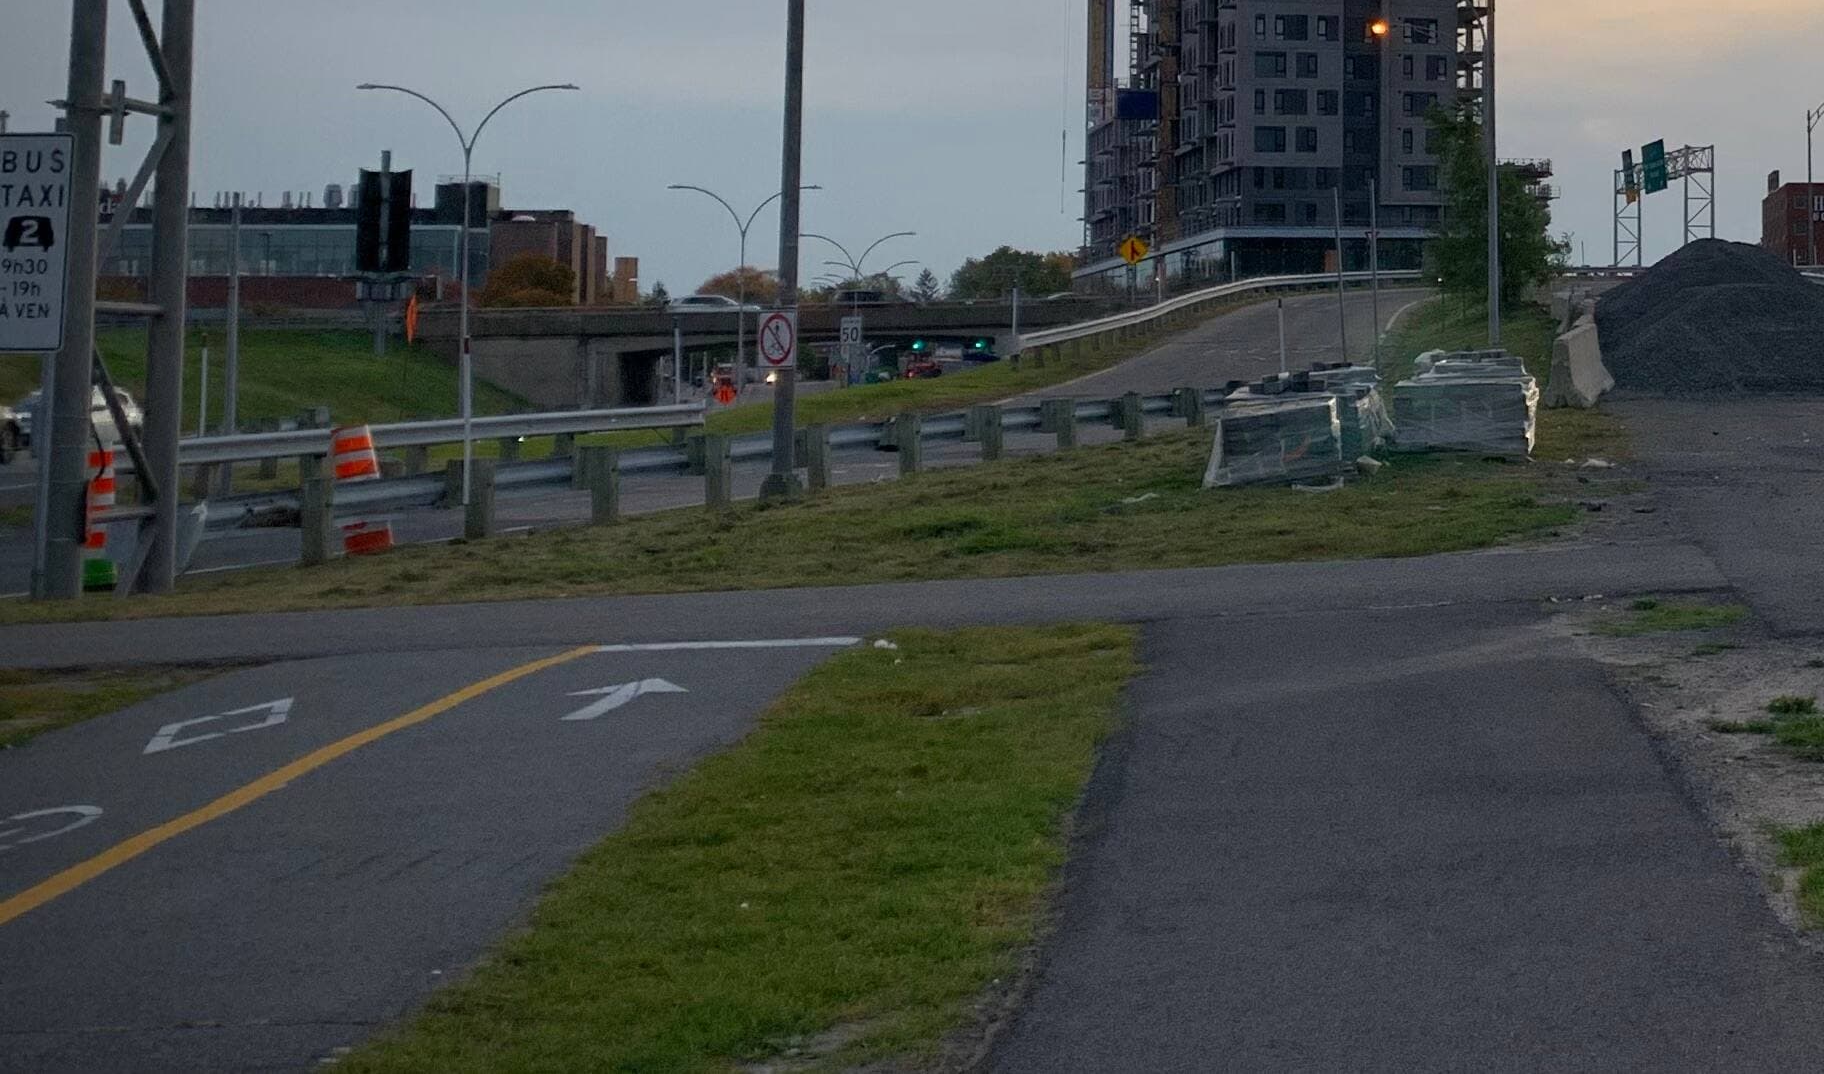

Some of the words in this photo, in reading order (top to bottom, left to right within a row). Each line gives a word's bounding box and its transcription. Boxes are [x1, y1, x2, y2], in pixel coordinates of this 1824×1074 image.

[2, 149, 65, 174] BUS
[1, 184, 65, 207] TAXI
[20, 220, 39, 244] 2
[2, 258, 48, 275] 9h30
[12, 281, 41, 297] 19h
[15, 303, 50, 318] VEN
[842, 326, 859, 342] 50
